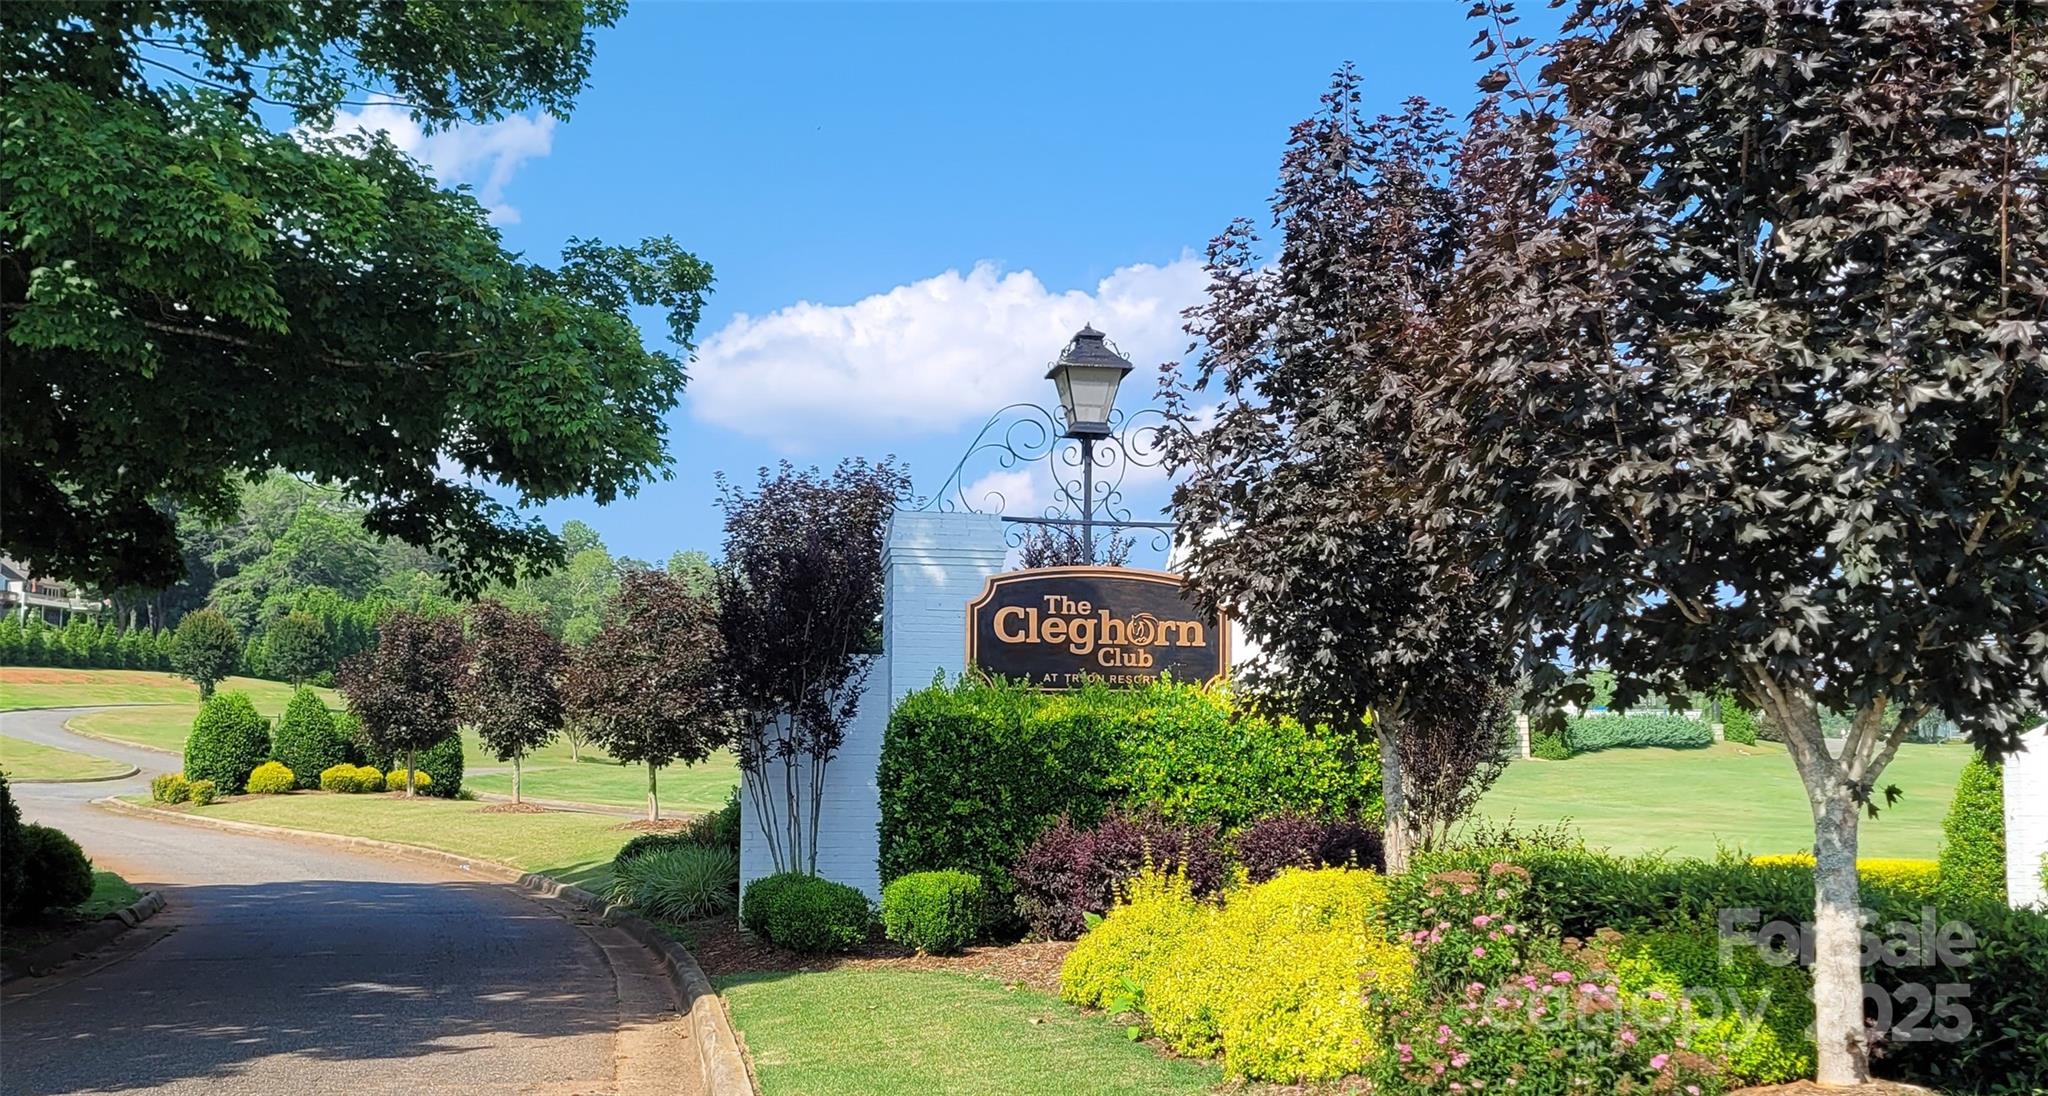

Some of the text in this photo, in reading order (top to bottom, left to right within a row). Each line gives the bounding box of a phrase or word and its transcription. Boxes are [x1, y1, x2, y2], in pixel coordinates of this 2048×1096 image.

[1043, 594, 1092, 616] The
[993, 606, 1206, 654] Cleghorn
[1097, 646, 1153, 668] Club
[1043, 673, 1059, 683] AT
[1064, 673, 1105, 684] TRON
